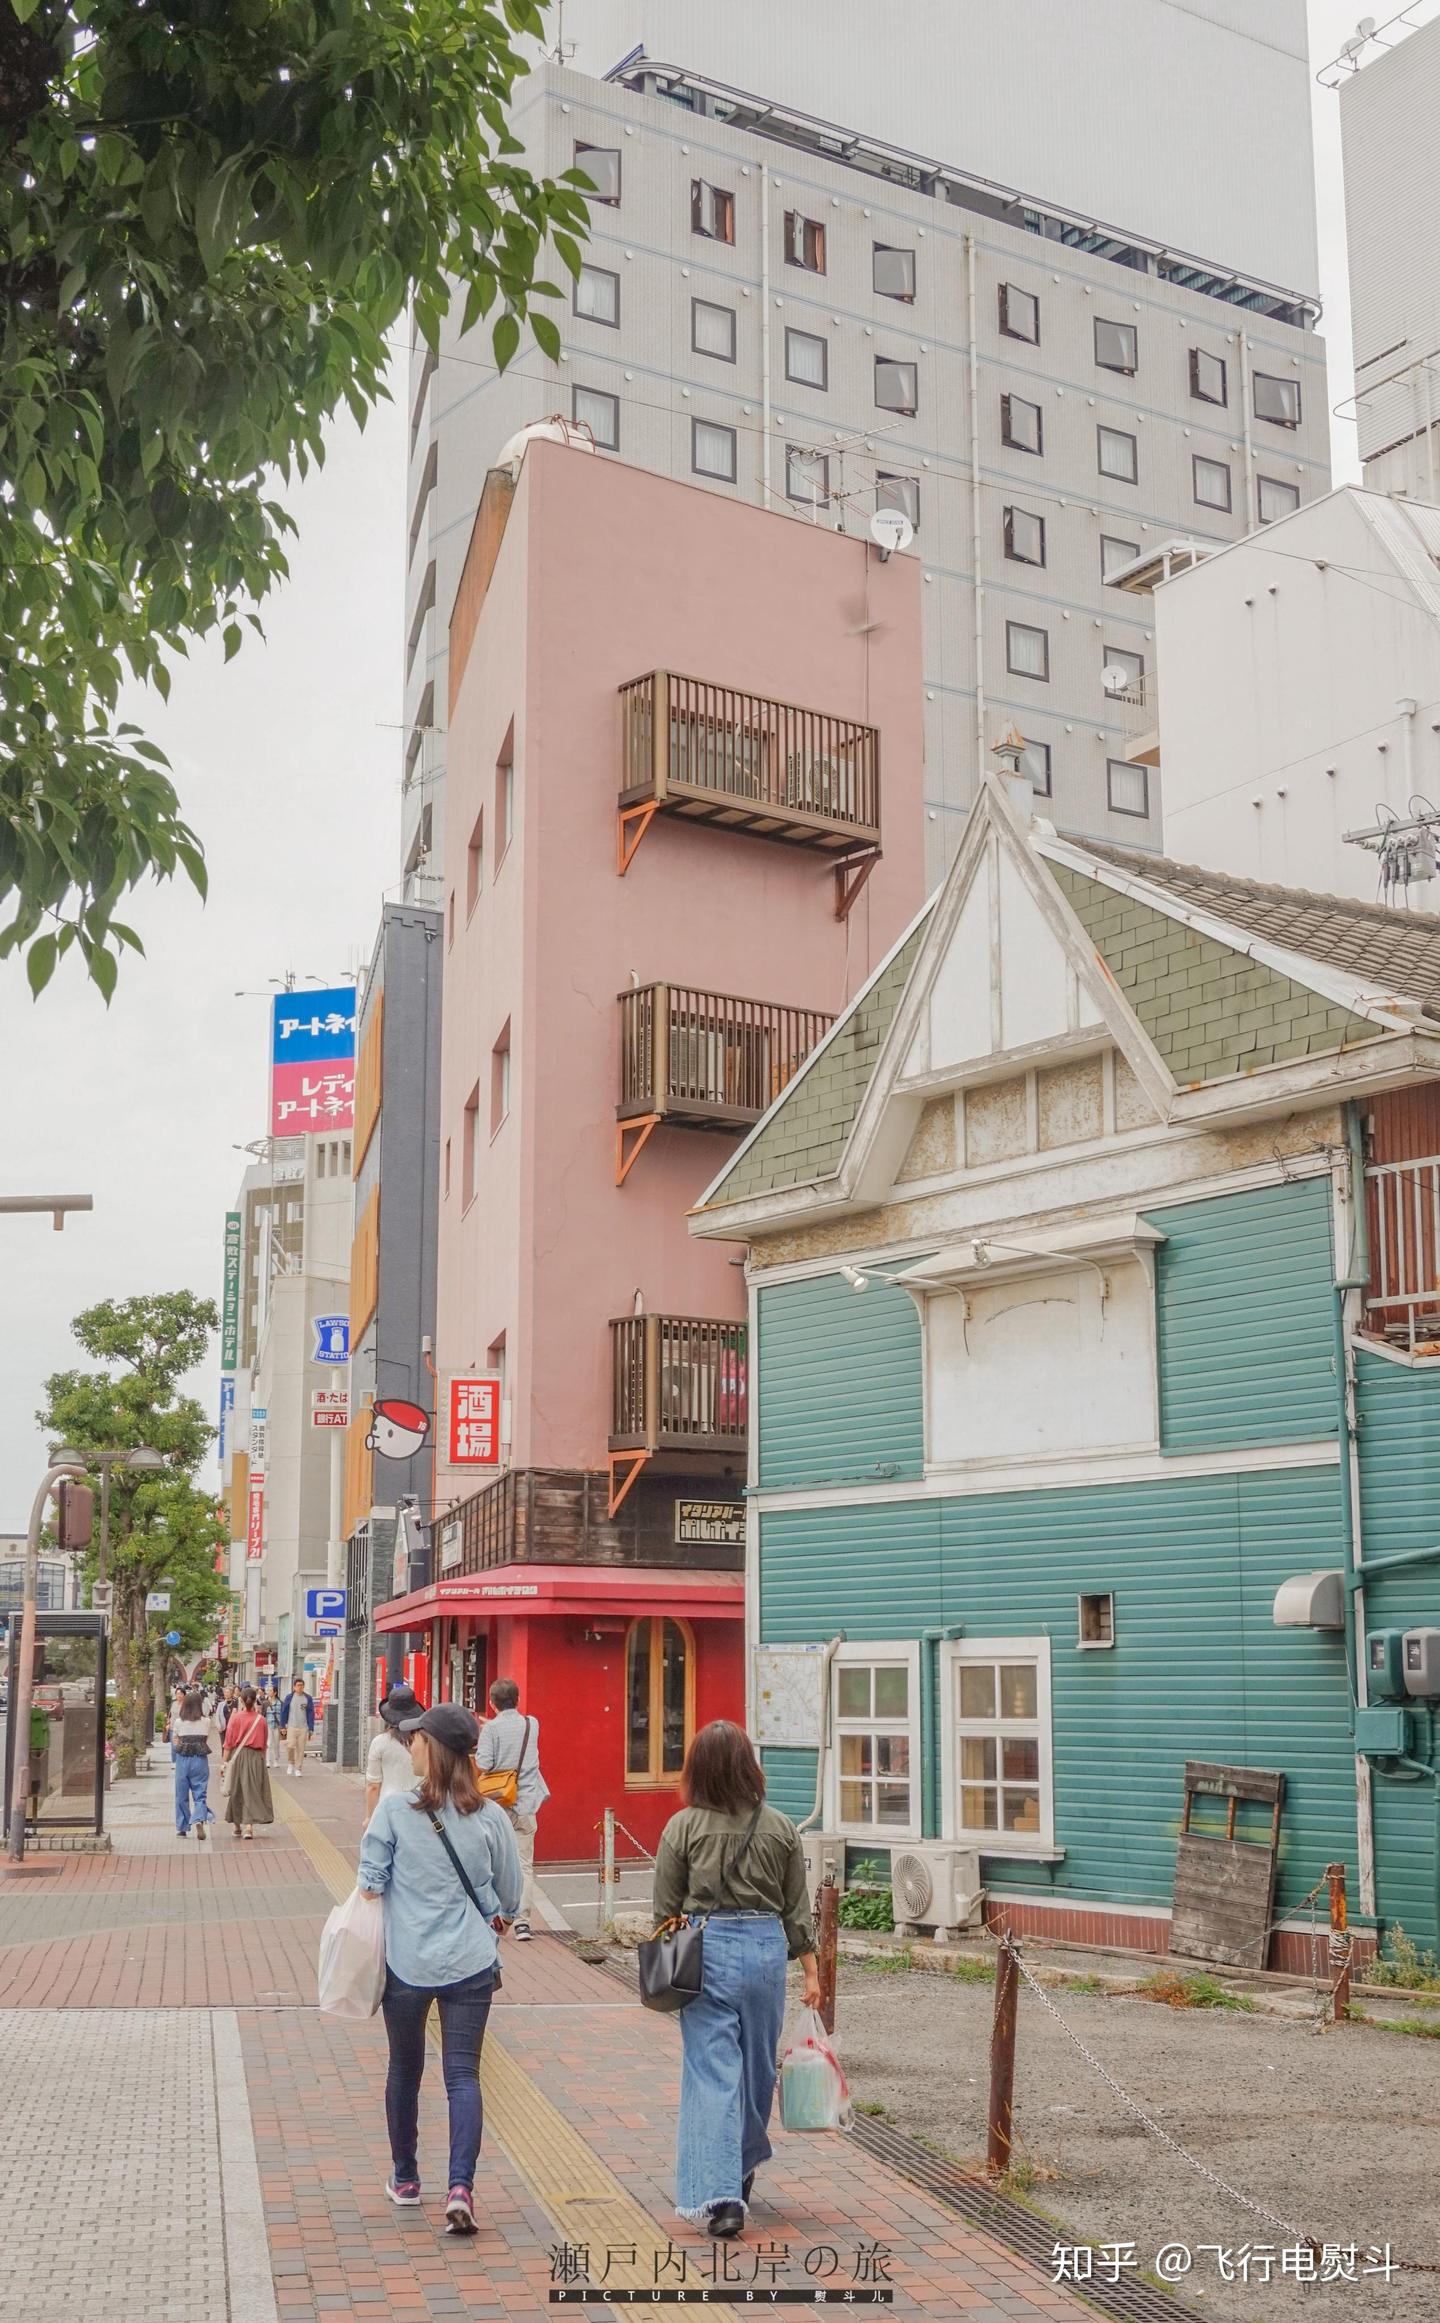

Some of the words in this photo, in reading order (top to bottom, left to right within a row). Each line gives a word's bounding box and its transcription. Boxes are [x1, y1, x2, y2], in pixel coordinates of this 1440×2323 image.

[302, 1074, 355, 1096] レディ
[457, 1385, 492, 1456] 酒場
[316, 1592, 343, 1616] P
